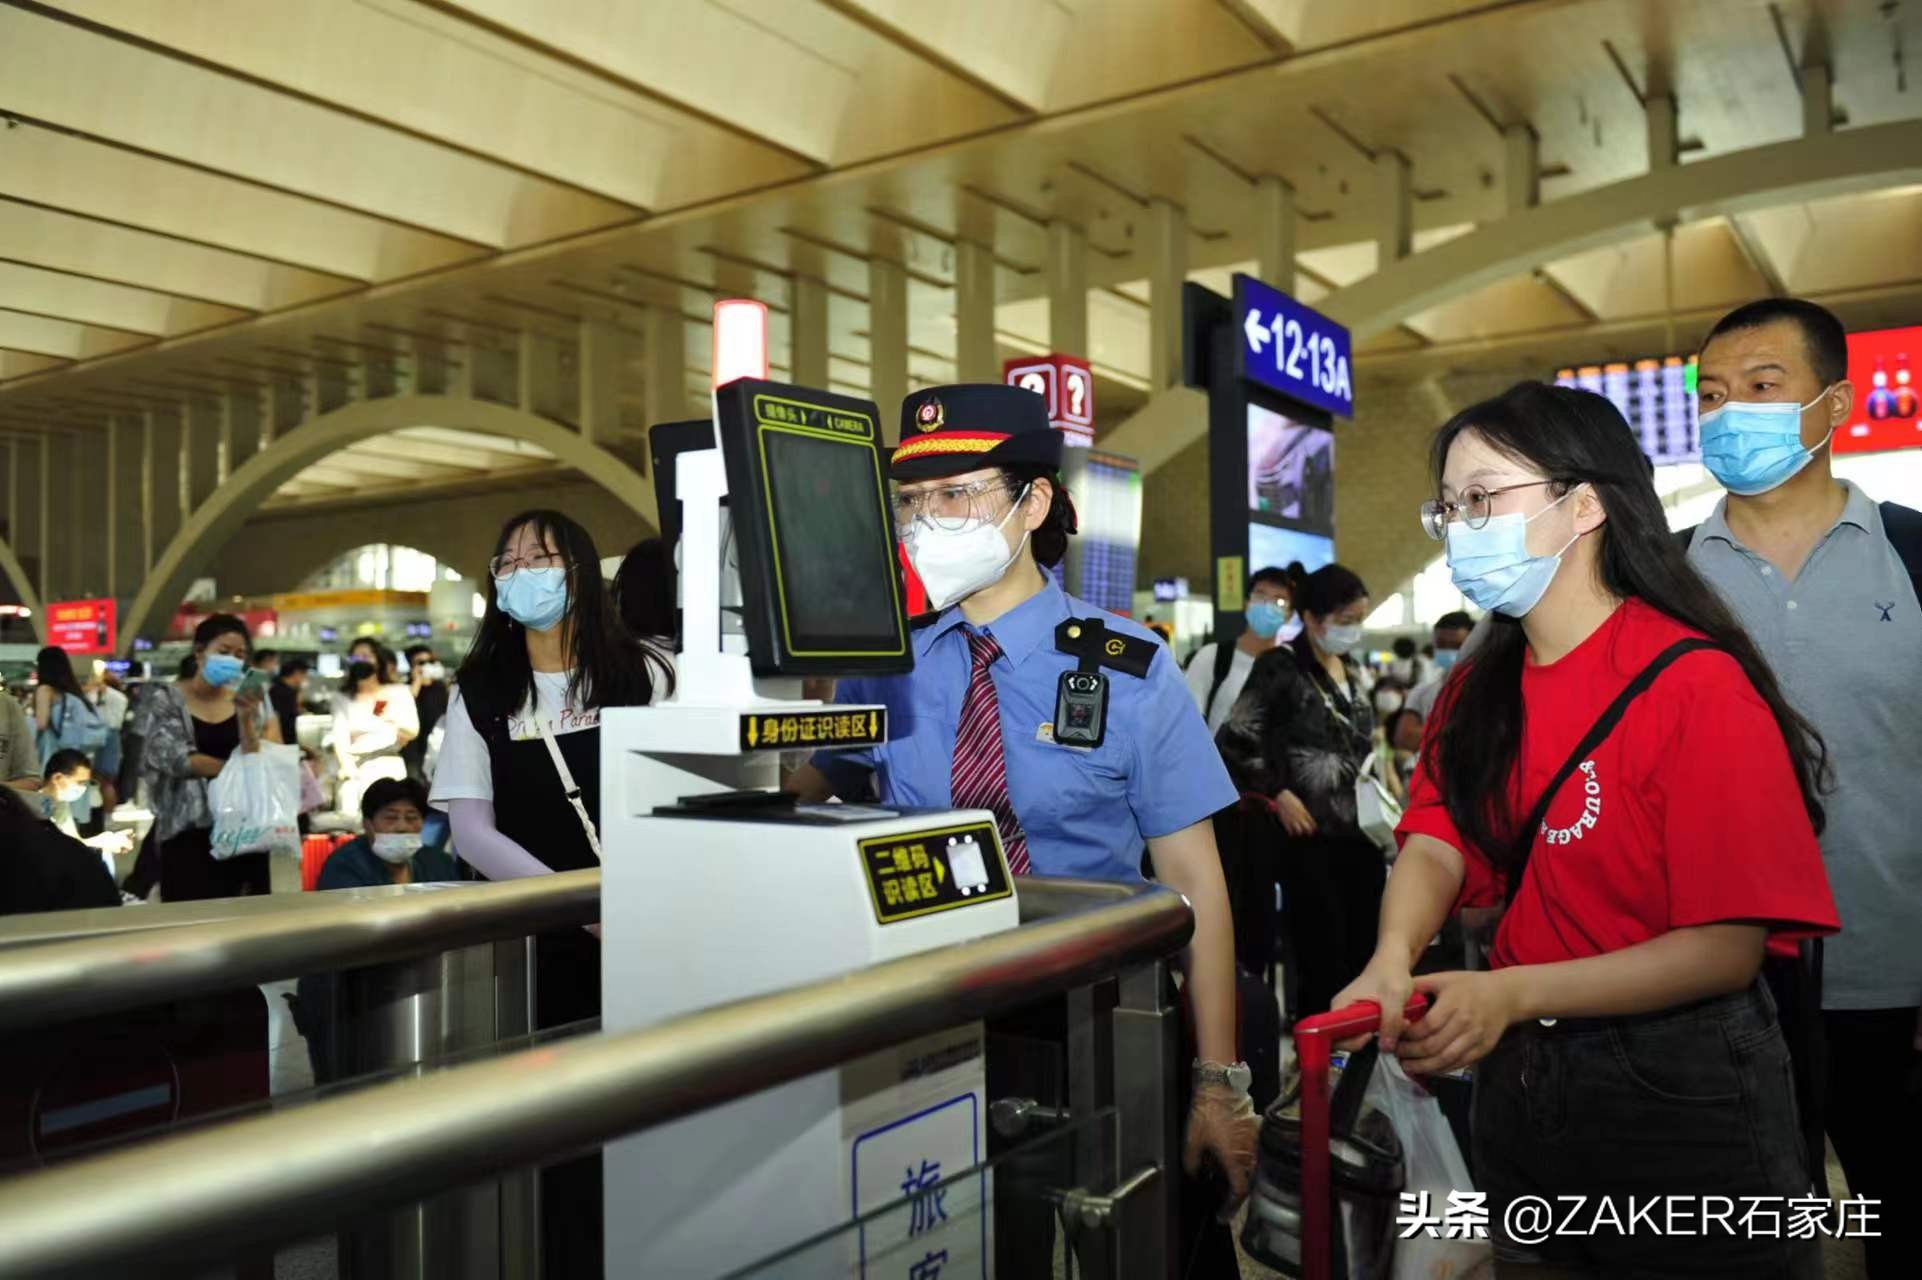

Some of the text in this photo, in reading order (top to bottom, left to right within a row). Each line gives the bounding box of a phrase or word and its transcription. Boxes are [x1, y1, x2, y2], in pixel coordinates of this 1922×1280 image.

[761, 714, 867, 744] 身份证识读区
[875, 844, 930, 875] 二维码
[882, 871, 939, 906] 识读区
